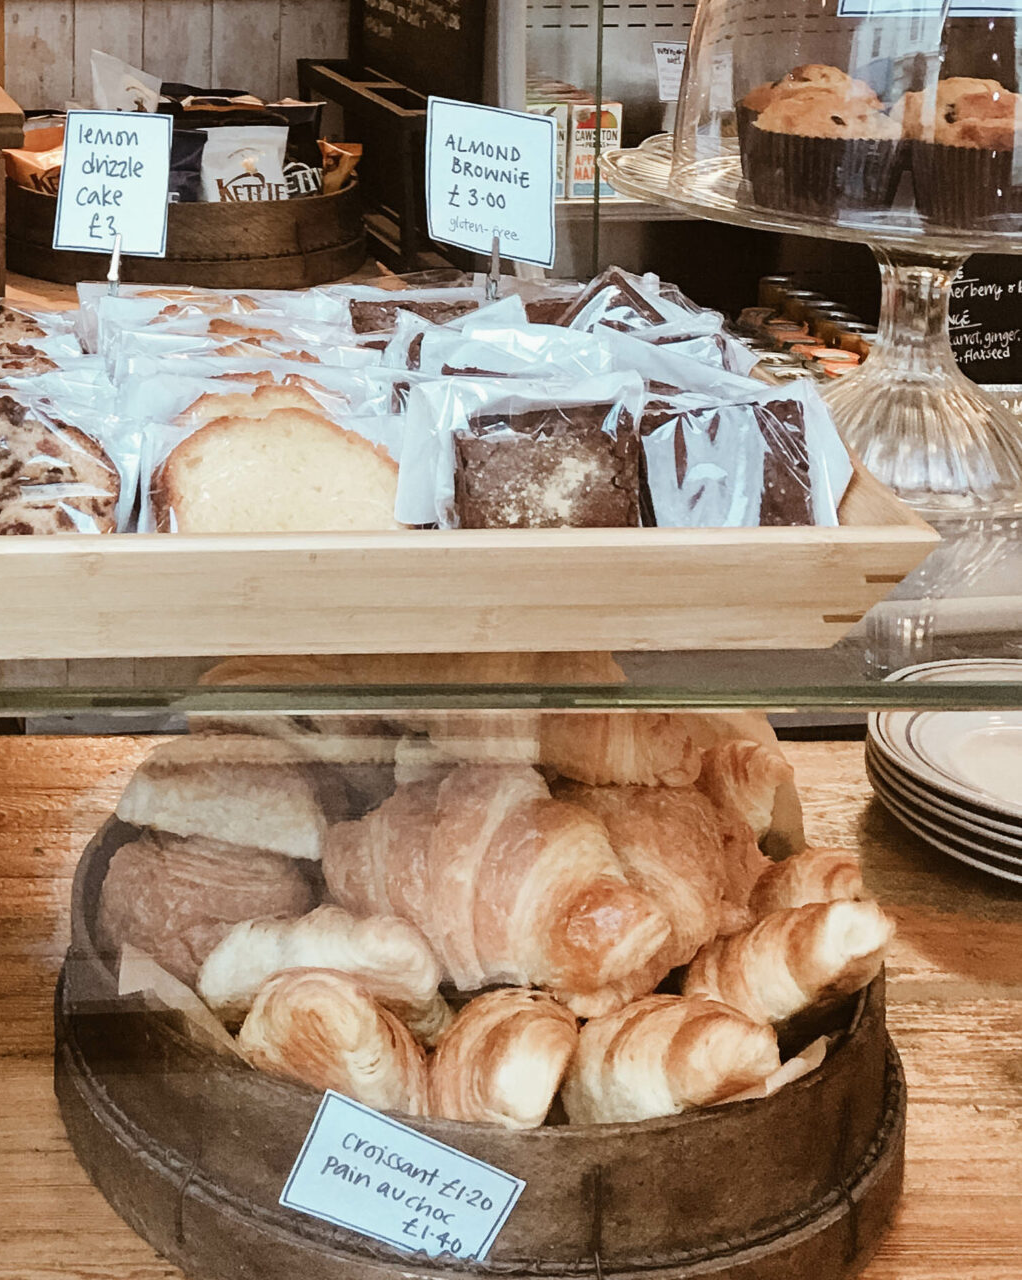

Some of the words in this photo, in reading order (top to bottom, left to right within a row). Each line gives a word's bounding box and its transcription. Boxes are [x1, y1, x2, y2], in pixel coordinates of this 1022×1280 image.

[79, 124, 139, 147] lemon
[445, 134, 521, 162] ALMOND
[82, 152, 144, 179] drizzle
[76, 184, 124, 207] cake
[88, 214, 117, 239] £3
[970, 282, 1003, 301] berry
[964, 347, 1011, 364] flaxseed
[377, 1181, 406, 1202] au
[405, 1195, 456, 1226] choc
[438, 1179, 493, 1211] £1.20
[402, 1218, 462, 1254] £1.40
